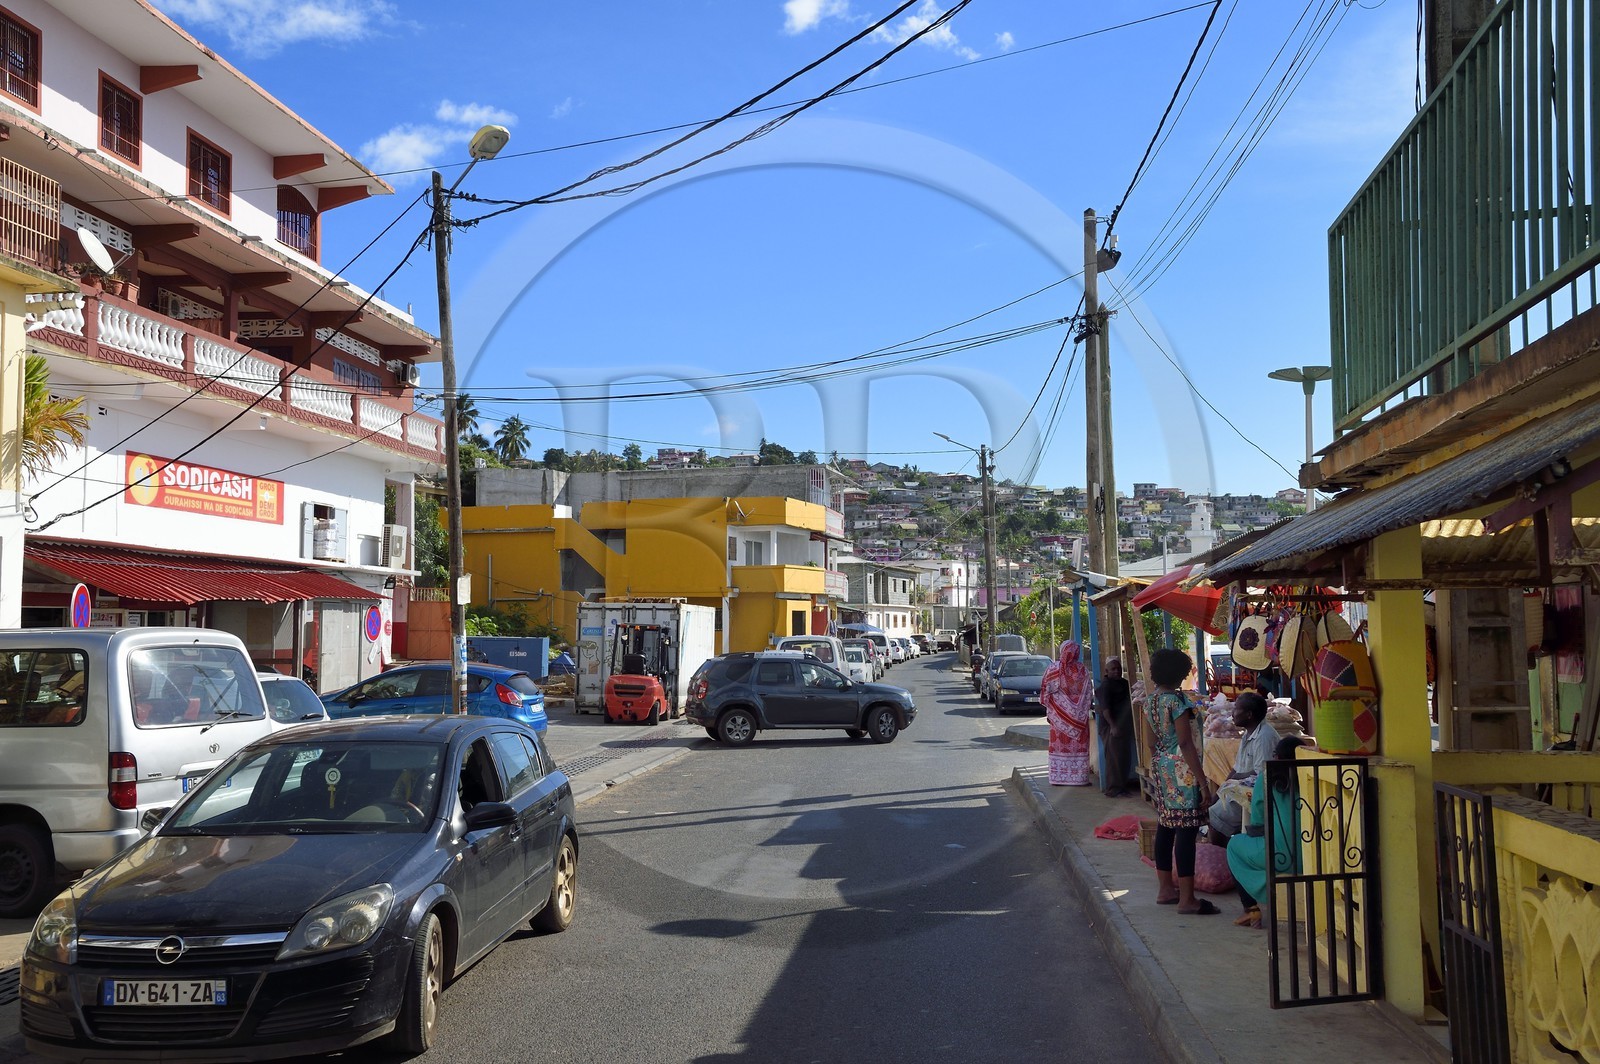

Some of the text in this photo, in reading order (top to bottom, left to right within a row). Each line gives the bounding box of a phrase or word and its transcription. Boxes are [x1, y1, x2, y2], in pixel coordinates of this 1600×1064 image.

[163, 463, 252, 500] SODICASH
[259, 482, 275, 491] GROS
[164, 496, 253, 517] OURAHISSI WA DE SODICASH
[259, 500, 275, 511] DEMI
[259, 509, 275, 519] GROS
[116, 983, 213, 1003] DX-641-ZA
[217, 993, 225, 1002] 63
